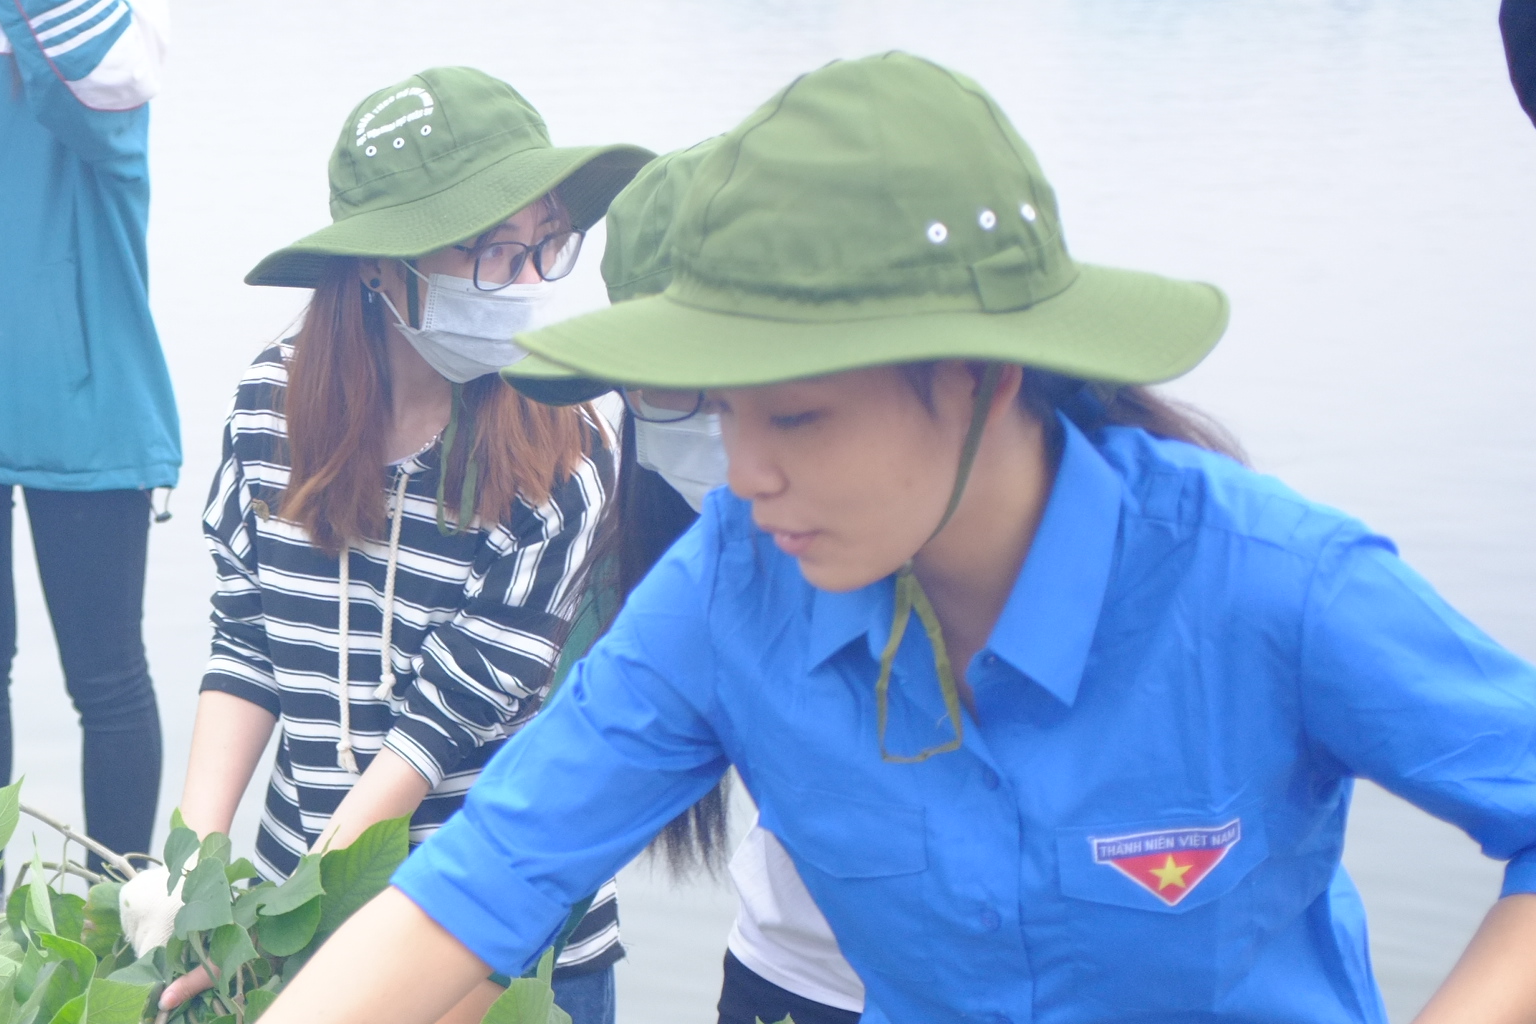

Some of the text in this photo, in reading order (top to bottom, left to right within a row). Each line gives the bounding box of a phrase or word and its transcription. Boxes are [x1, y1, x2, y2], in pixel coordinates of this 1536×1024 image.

[1100, 828, 1235, 857] THANH NIÊN VIỆT NAM
